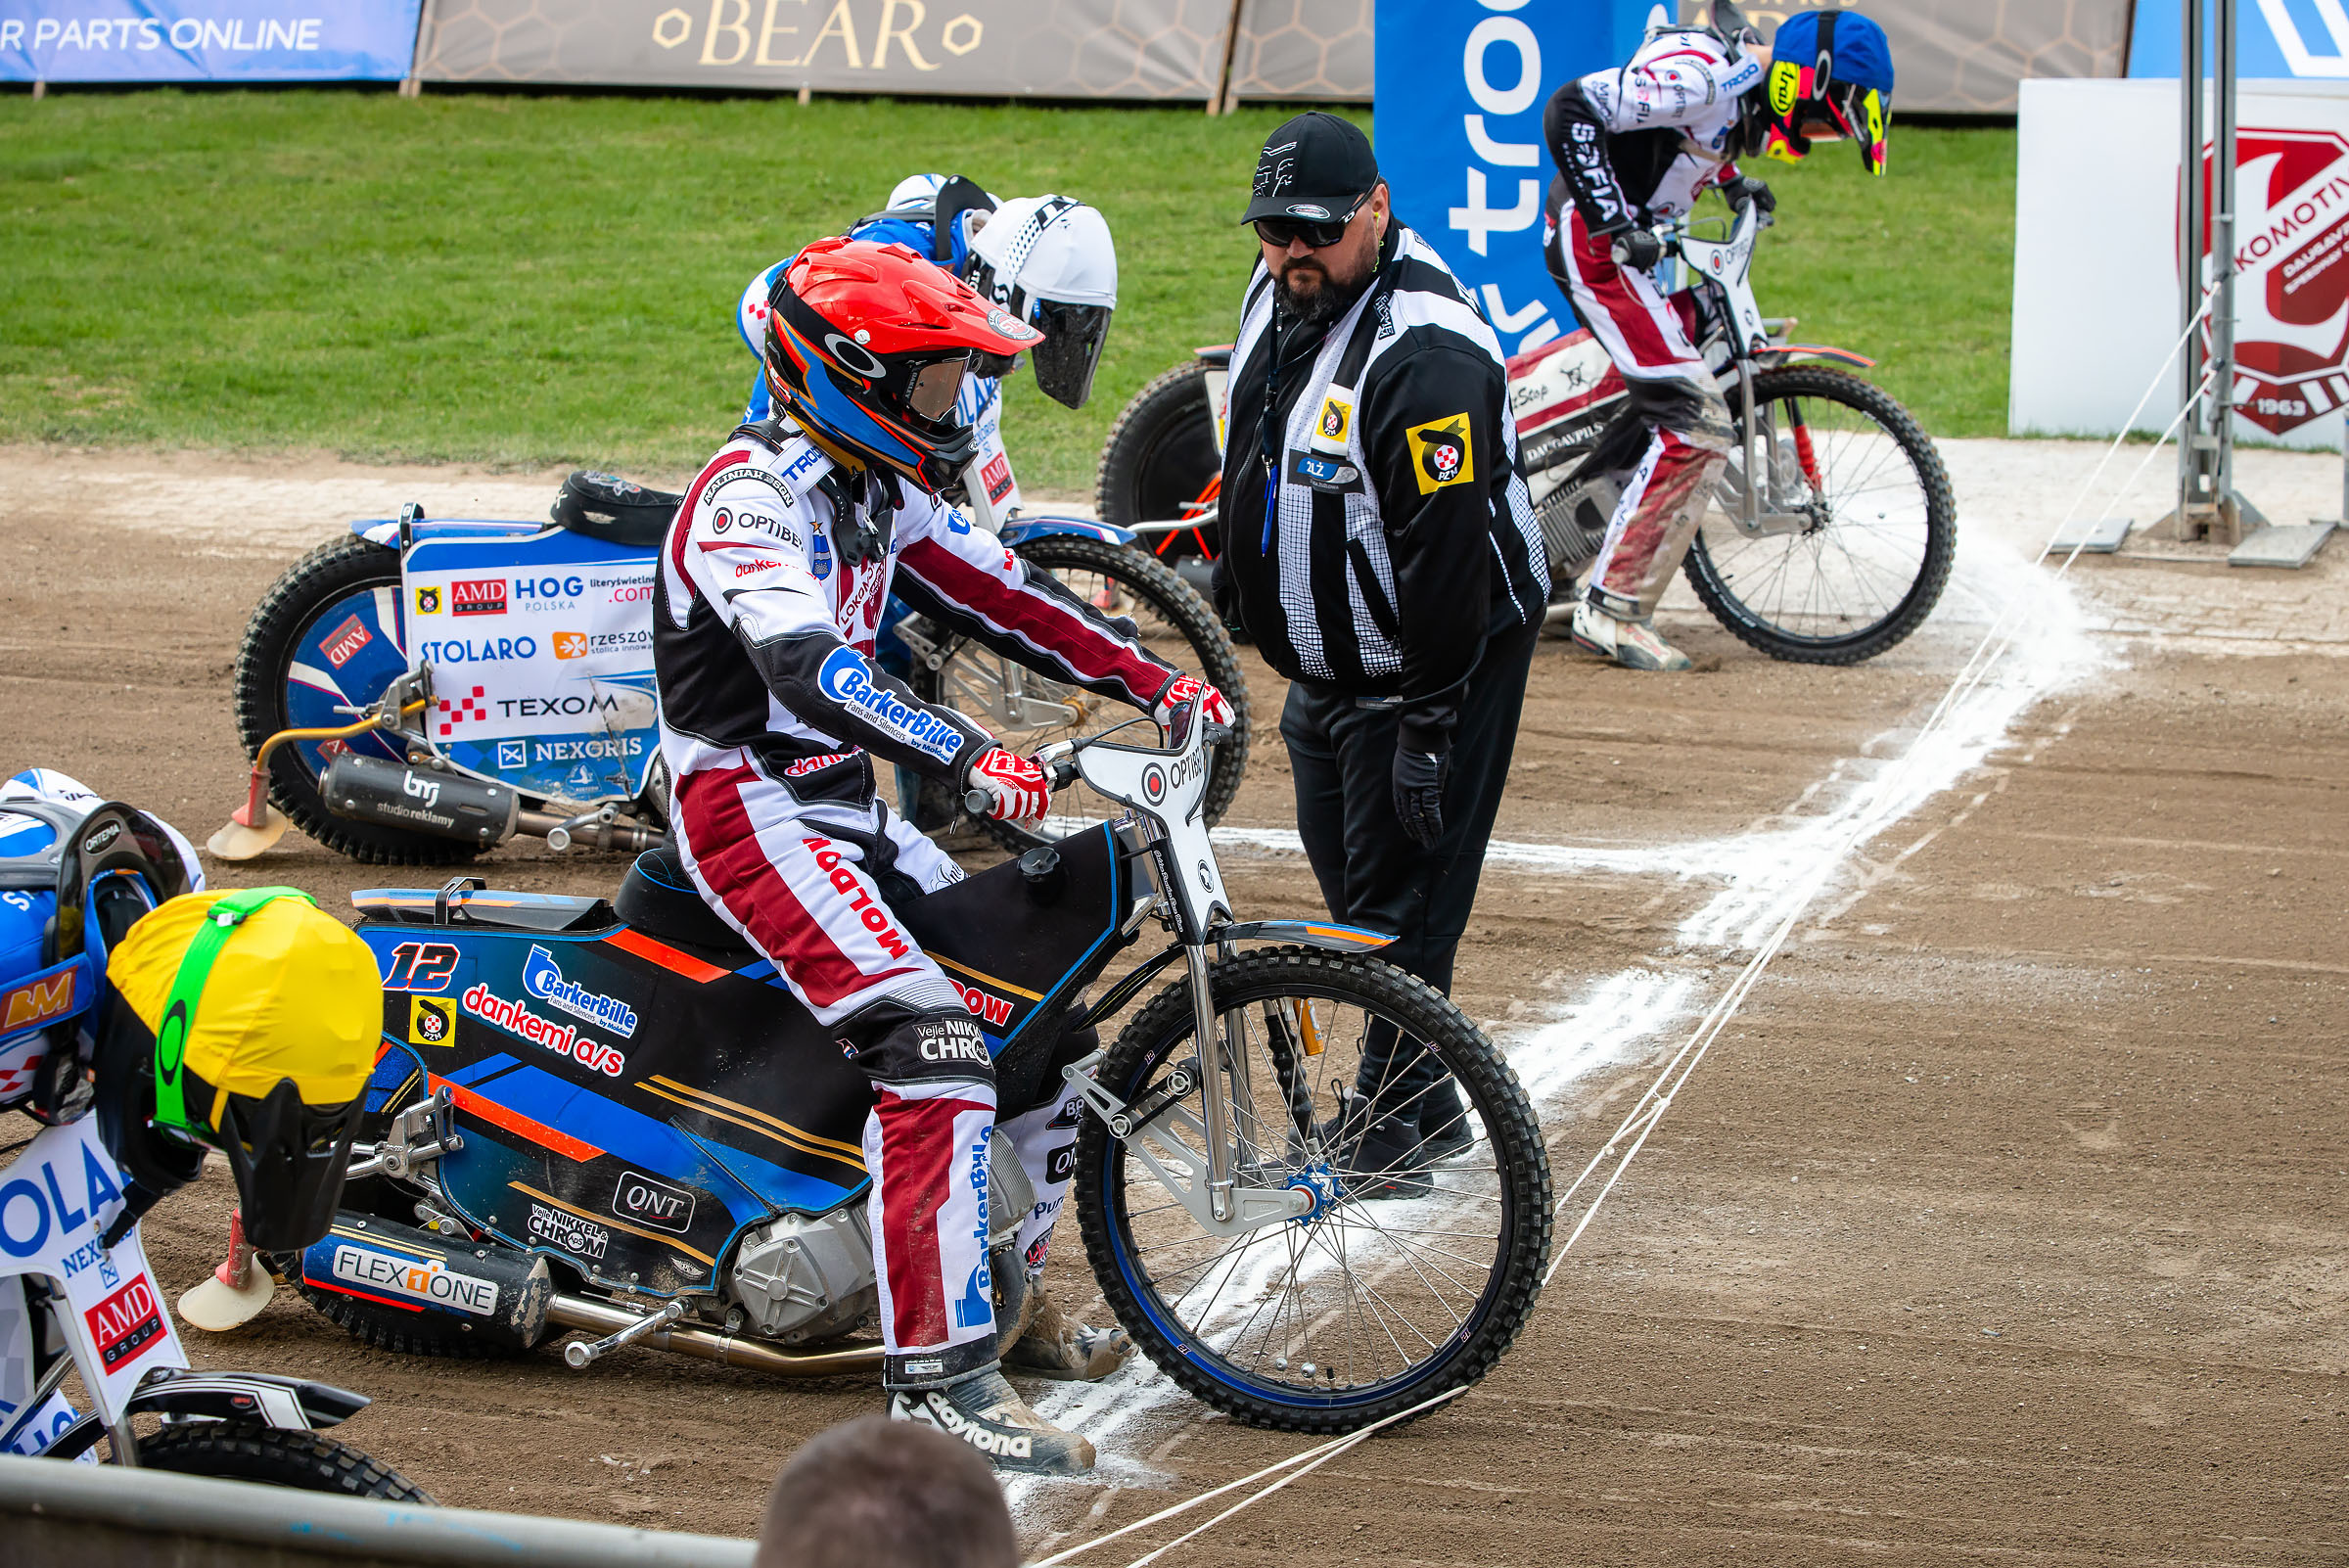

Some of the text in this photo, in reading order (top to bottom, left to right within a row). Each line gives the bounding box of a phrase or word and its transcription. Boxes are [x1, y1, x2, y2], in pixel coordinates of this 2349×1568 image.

[34, 19, 161, 51] PARTS
[169, 19, 323, 52] ONLINE
[699, 0, 943, 70] BEAR
[1449, 0, 1543, 257] tro
[2257, 398, 2307, 416] 1963
[985, 456, 1008, 489] AMD
[1437, 469, 1458, 482] PZM
[453, 581, 505, 602] AMD
[515, 576, 583, 600] HOG
[455, 602, 504, 612] GROUP
[525, 600, 576, 612] POLSKA
[329, 625, 367, 666] AMD
[421, 636, 536, 665] STOLARO
[590, 644, 619, 655] stolica
[497, 693, 619, 718] TEXOM
[840, 670, 963, 755] BarkerBille
[847, 700, 907, 741] Fans and Silencers
[535, 737, 642, 762] NEXORIS
[911, 738, 950, 762] by Moldow
[382, 942, 460, 992] 12
[541, 972, 637, 1030] BarkerBille
[550, 996, 596, 1022] Fans and Silencers
[423, 1032, 442, 1041] PZM
[464, 983, 623, 1076] dankemi a/s
[598, 1018, 631, 1037] by Moldow
[917, 1025, 944, 1038] Vejle
[0, 1138, 133, 1259] OLA
[625, 1184, 684, 1219] QNT
[529, 1217, 606, 1258] CHROM
[532, 1205, 551, 1221] Vejle
[552, 1211, 599, 1238] NIKKEL
[568, 1235, 583, 1246] ApS
[97, 1282, 155, 1348] AMD
[106, 1317, 161, 1365] GROUP
[926, 1392, 1032, 1458] daytona
